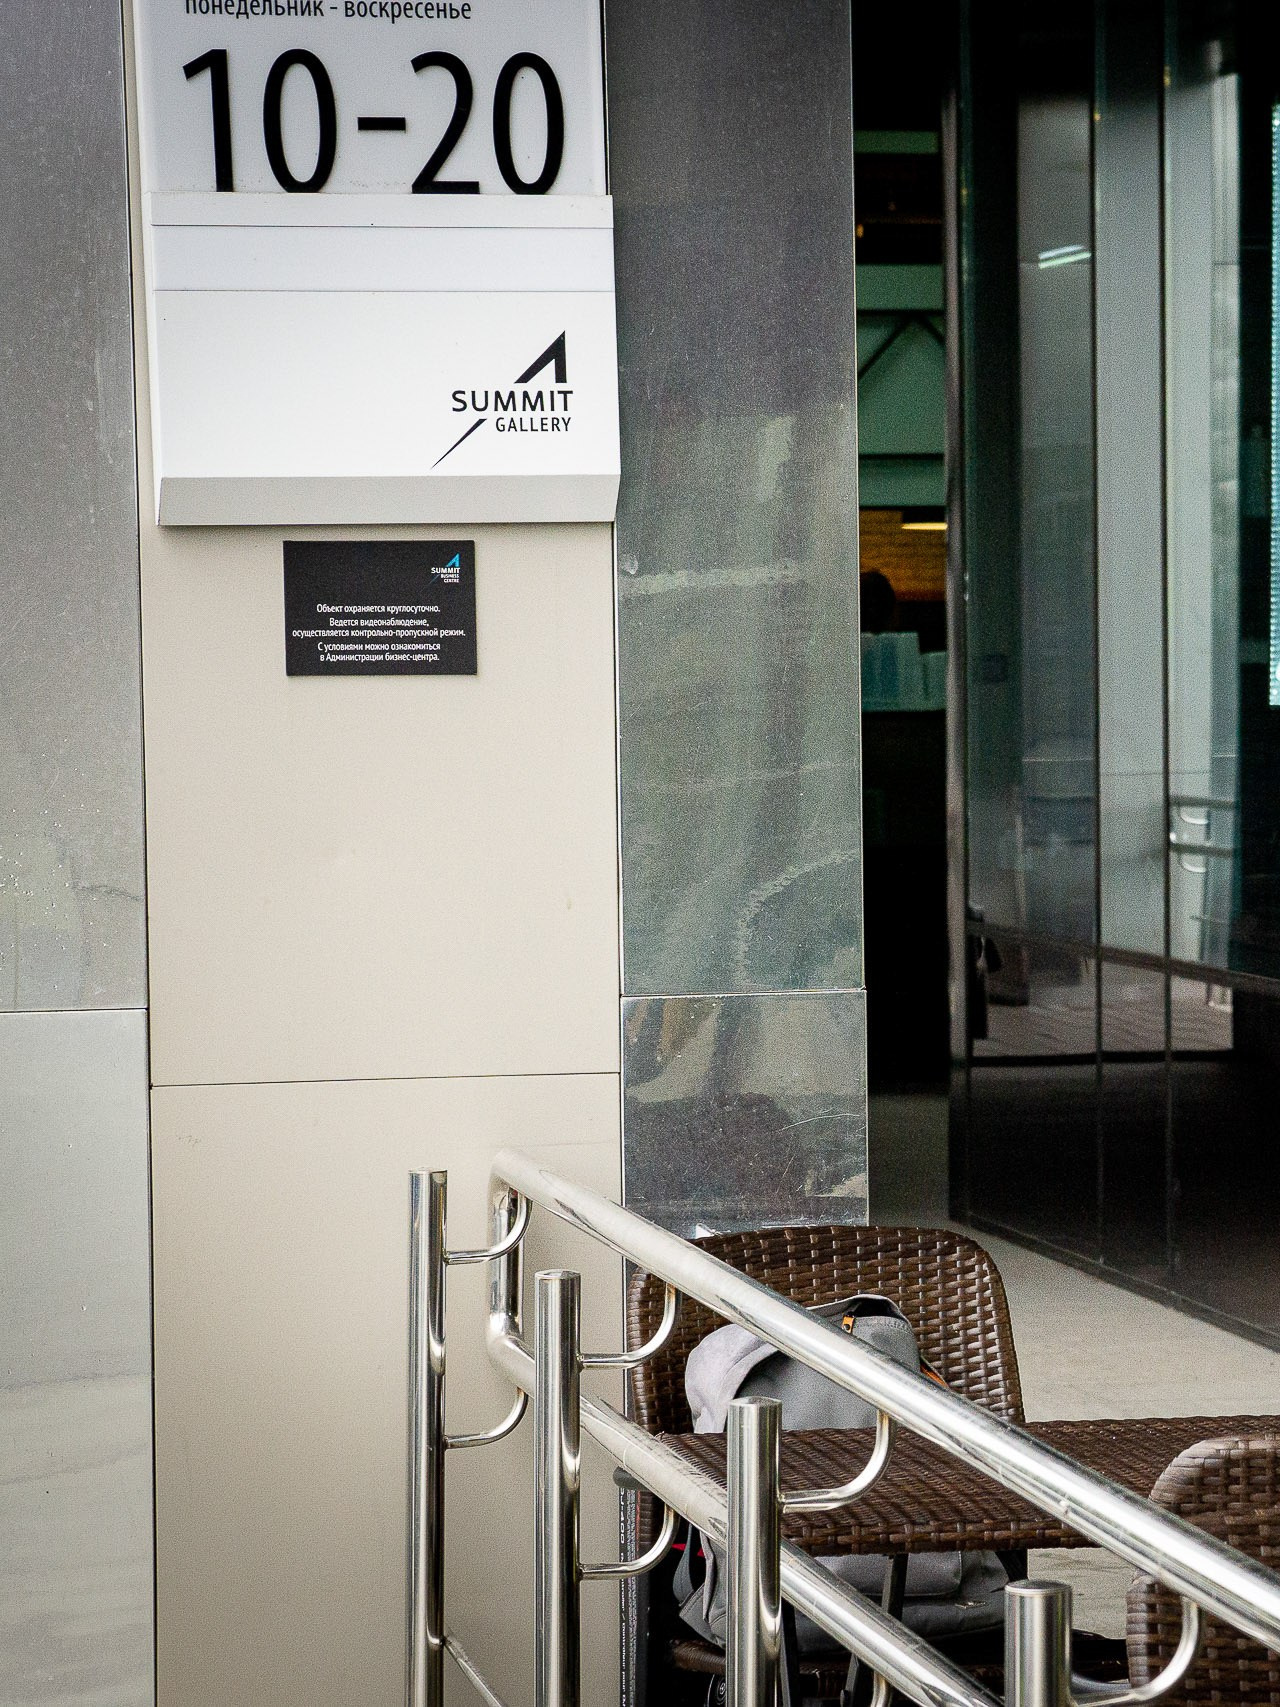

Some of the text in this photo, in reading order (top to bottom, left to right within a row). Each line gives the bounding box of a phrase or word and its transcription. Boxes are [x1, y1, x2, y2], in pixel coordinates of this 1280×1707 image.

[185, 0, 324, 19] понедельник
[344, 1, 472, 24] воскресенье
[451, 390, 574, 412] SUMMIT
[495, 417, 571, 432] GALLERY
[316, 603, 441, 615] Объект охраняется круглосуточно.
[329, 617, 430, 627] Ведется видеонаблюдение,
[292, 628, 466, 639] осуществляется контрольно-пропускной режим.
[324, 644, 364, 652] условиями
[390, 643, 441, 651] ознакомиться
[325, 653, 384, 663] Администрации
[385, 653, 440, 662] бизнес-центра.
